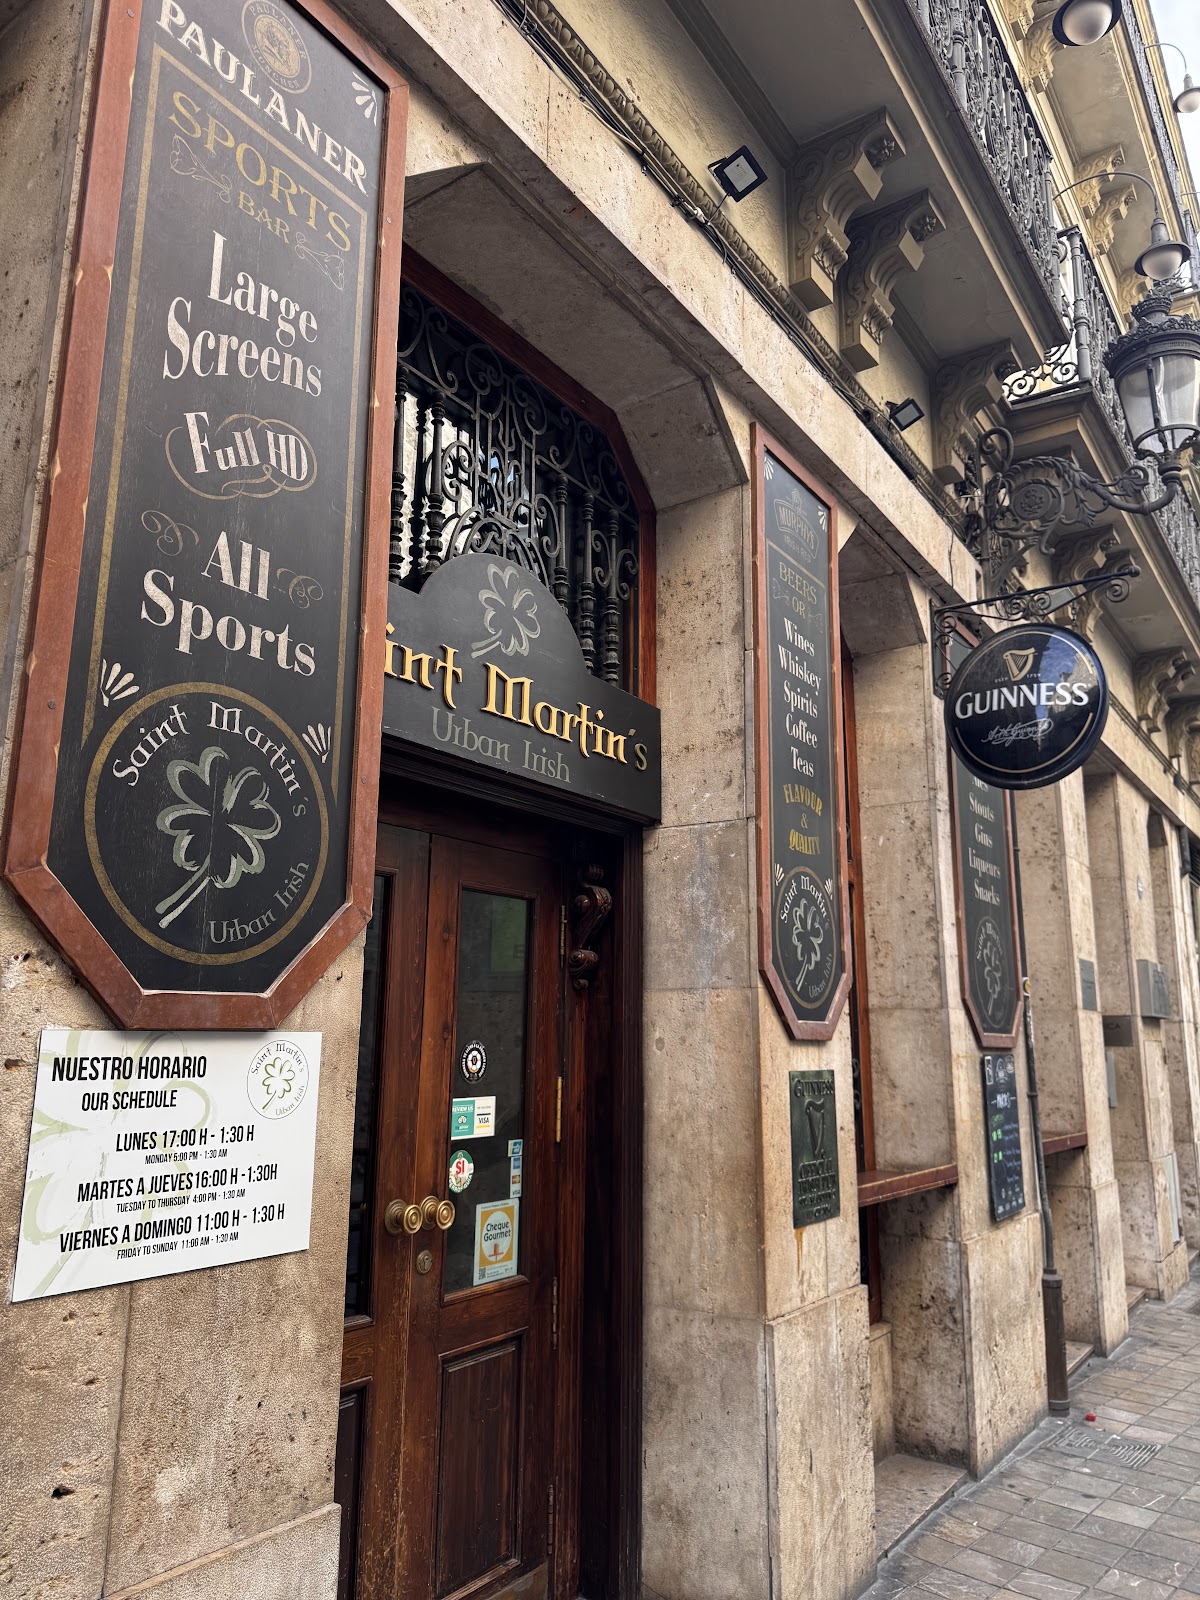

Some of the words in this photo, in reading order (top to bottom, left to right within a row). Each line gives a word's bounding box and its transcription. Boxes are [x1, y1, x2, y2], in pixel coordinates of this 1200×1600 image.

[249, 3, 307, 60] PAULANER
[156, 0, 369, 197] PAULANER
[168, 91, 351, 252] SPORTS
[238, 191, 290, 244] BAR
[207, 230, 318, 347] Large
[162, 296, 322, 398] Screens
[183, 411, 261, 474] Full
[265, 429, 309, 481] HD
[201, 530, 271, 601] All
[779, 561, 817, 604] BEERS
[140, 568, 316, 677] Sports
[791, 596, 806, 618] OR
[783, 617, 815, 657] Wines
[384, 621, 463, 710] int
[777, 644, 822, 696] Whiskey
[783, 680, 818, 718] Spirits
[954, 682, 1090, 720] GUINNESS
[112, 703, 191, 787] Saint
[431, 706, 512, 763] Urban
[523, 740, 571, 784] Irish
[785, 712, 818, 749] Coffee
[790, 746, 814, 778] Teas
[783, 783, 822, 816] FLAVOUR
[968, 792, 994, 822] Stouts
[800, 812, 808, 828] &
[974, 822, 993, 848] Gins
[788, 828, 821, 854] QUALITY
[968, 847, 1000, 878] Liqueurs
[209, 909, 277, 943] Urban
[274, 861, 309, 910] Irish
[780, 879, 798, 923] Saint
[974, 878, 1000, 906] Snacks
[52, 1057, 133, 1082] NUESTRO
[137, 1055, 207, 1080] HORARIO
[251, 1047, 272, 1074] Saint
[81, 1092, 109, 1111] OUR
[112, 1090, 177, 1110] SCHEDULE
[116, 1131, 157, 1152] LUNES
[162, 1129, 196, 1148] 17:00
[199, 1128, 208, 1146] H
[220, 1125, 244, 1144] 1:30
[246, 1124, 255, 1141] H
[144, 1155, 173, 1165] MONDAY
[173, 1151, 188, 1162] 5:00
[188, 1151, 199, 1160] PM
[204, 1149, 217, 1159] 1:30
[218, 1148, 228, 1158] AM
[77, 1178, 134, 1203] MARTES
[136, 1177, 145, 1196] A
[148, 1172, 194, 1195] JUEVES
[195, 1168, 228, 1189] 16:00
[230, 1167, 239, 1185] H
[455, 1160, 465, 1175] SI
[116, 1201, 147, 1213] TUESDAY
[148, 1199, 156, 1209] TO
[157, 1195, 190, 1208] THURSDAY
[192, 1193, 207, 1203] 4:00
[207, 1192, 217, 1202] PM
[223, 1190, 235, 1200] 1:30
[236, 1188, 246, 1198] AM
[60, 1226, 119, 1253] VIERNES
[121, 1224, 131, 1243] A
[134, 1215, 192, 1242] DOMINGO
[196, 1211, 229, 1232] 11:00
[231, 1209, 240, 1227] H
[252, 1204, 275, 1224] 1:30
[277, 1203, 285, 1220] H
[483, 1229, 511, 1242] Gourmet
[485, 1221, 510, 1232] Cheque
[116, 1247, 141, 1260] FRIDAY
[143, 1245, 151, 1256] TO
[152, 1240, 178, 1254] SUNDAY
[181, 1237, 199, 1249] 11:00
[200, 1236, 210, 1246] AM
[216, 1233, 229, 1243] 1:30
[230, 1231, 239, 1241] AM
